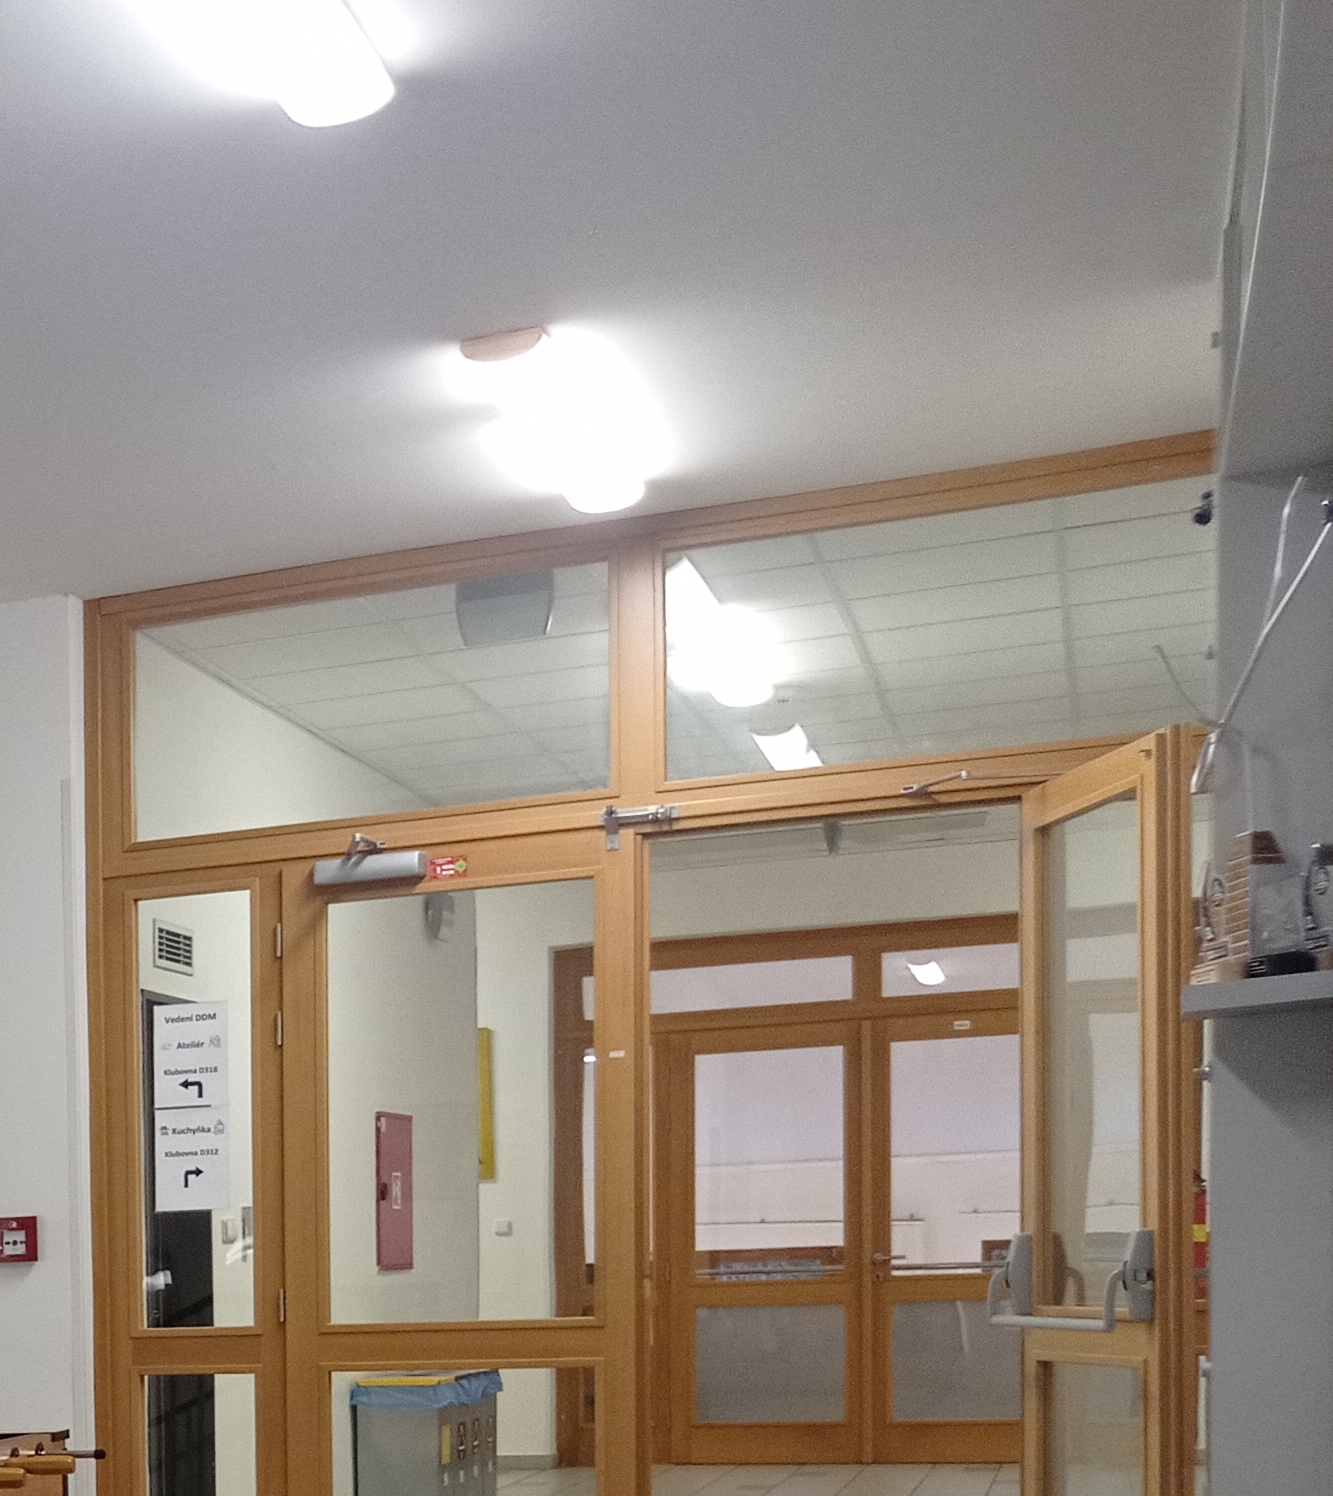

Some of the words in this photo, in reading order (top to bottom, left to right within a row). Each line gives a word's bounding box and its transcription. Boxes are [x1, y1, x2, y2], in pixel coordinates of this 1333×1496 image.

[164, 1014, 193, 1024] Vedení
[176, 1041, 204, 1050] Ateliér
[164, 1068, 197, 1076] Klubovna
[171, 1126, 211, 1135] Kuchyňka
[164, 1150, 198, 1158] Klubovna
[200, 1148, 219, 1156] D312
